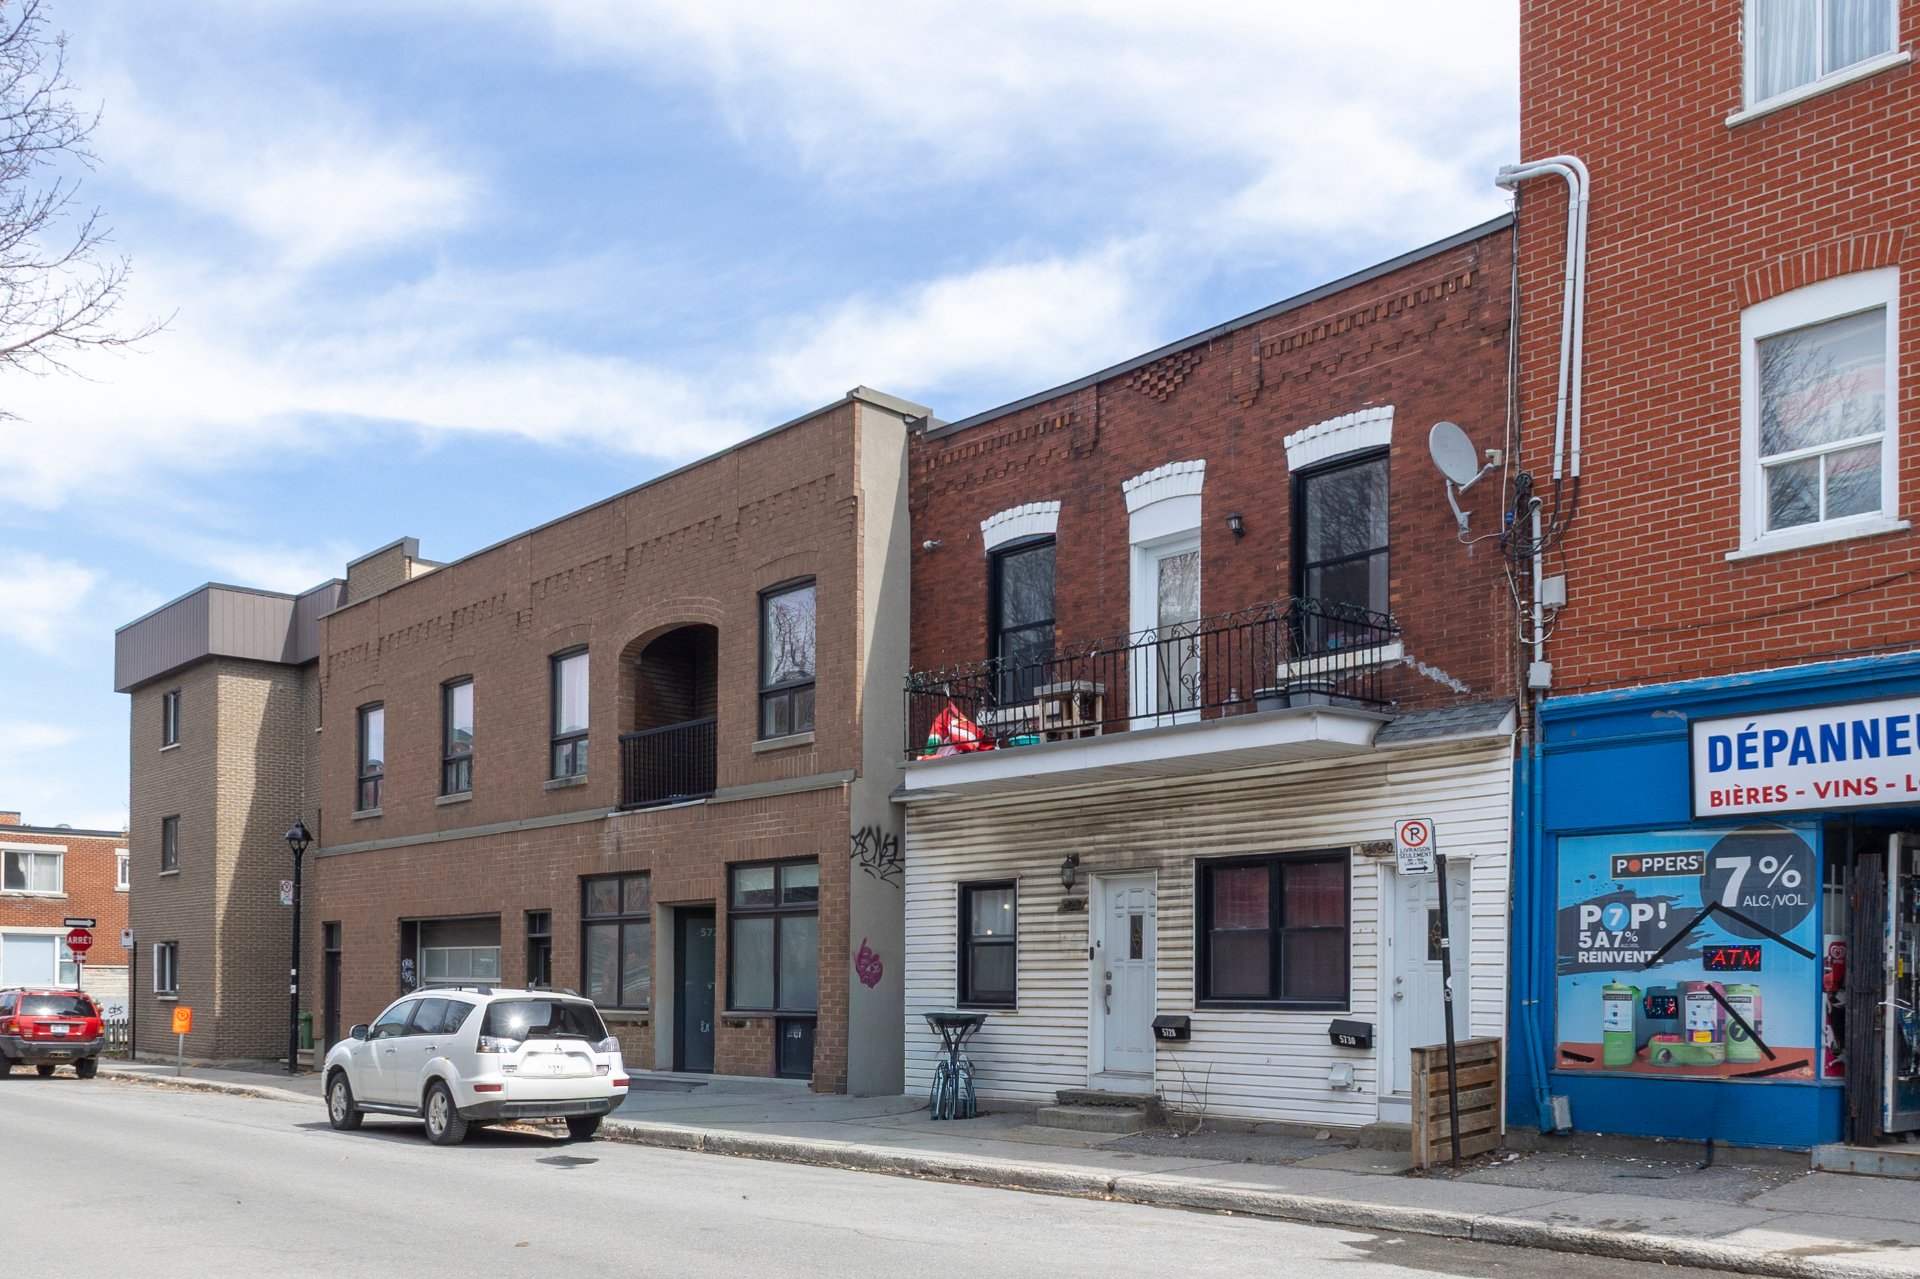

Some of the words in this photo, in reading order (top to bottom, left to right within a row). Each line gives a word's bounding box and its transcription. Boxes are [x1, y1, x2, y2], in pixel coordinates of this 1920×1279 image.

[1708, 714, 1920, 773] DÉPANNE
[1710, 784, 1788, 807] BIÈRES
[1813, 777, 1878, 799] VINS
[701, 928, 716, 936] 57
[67, 935, 92, 944] ARRÊT
[1711, 949, 1760, 965] ATM
[1161, 1028, 1176, 1036] 5728
[1339, 1035, 1355, 1044] 5730
